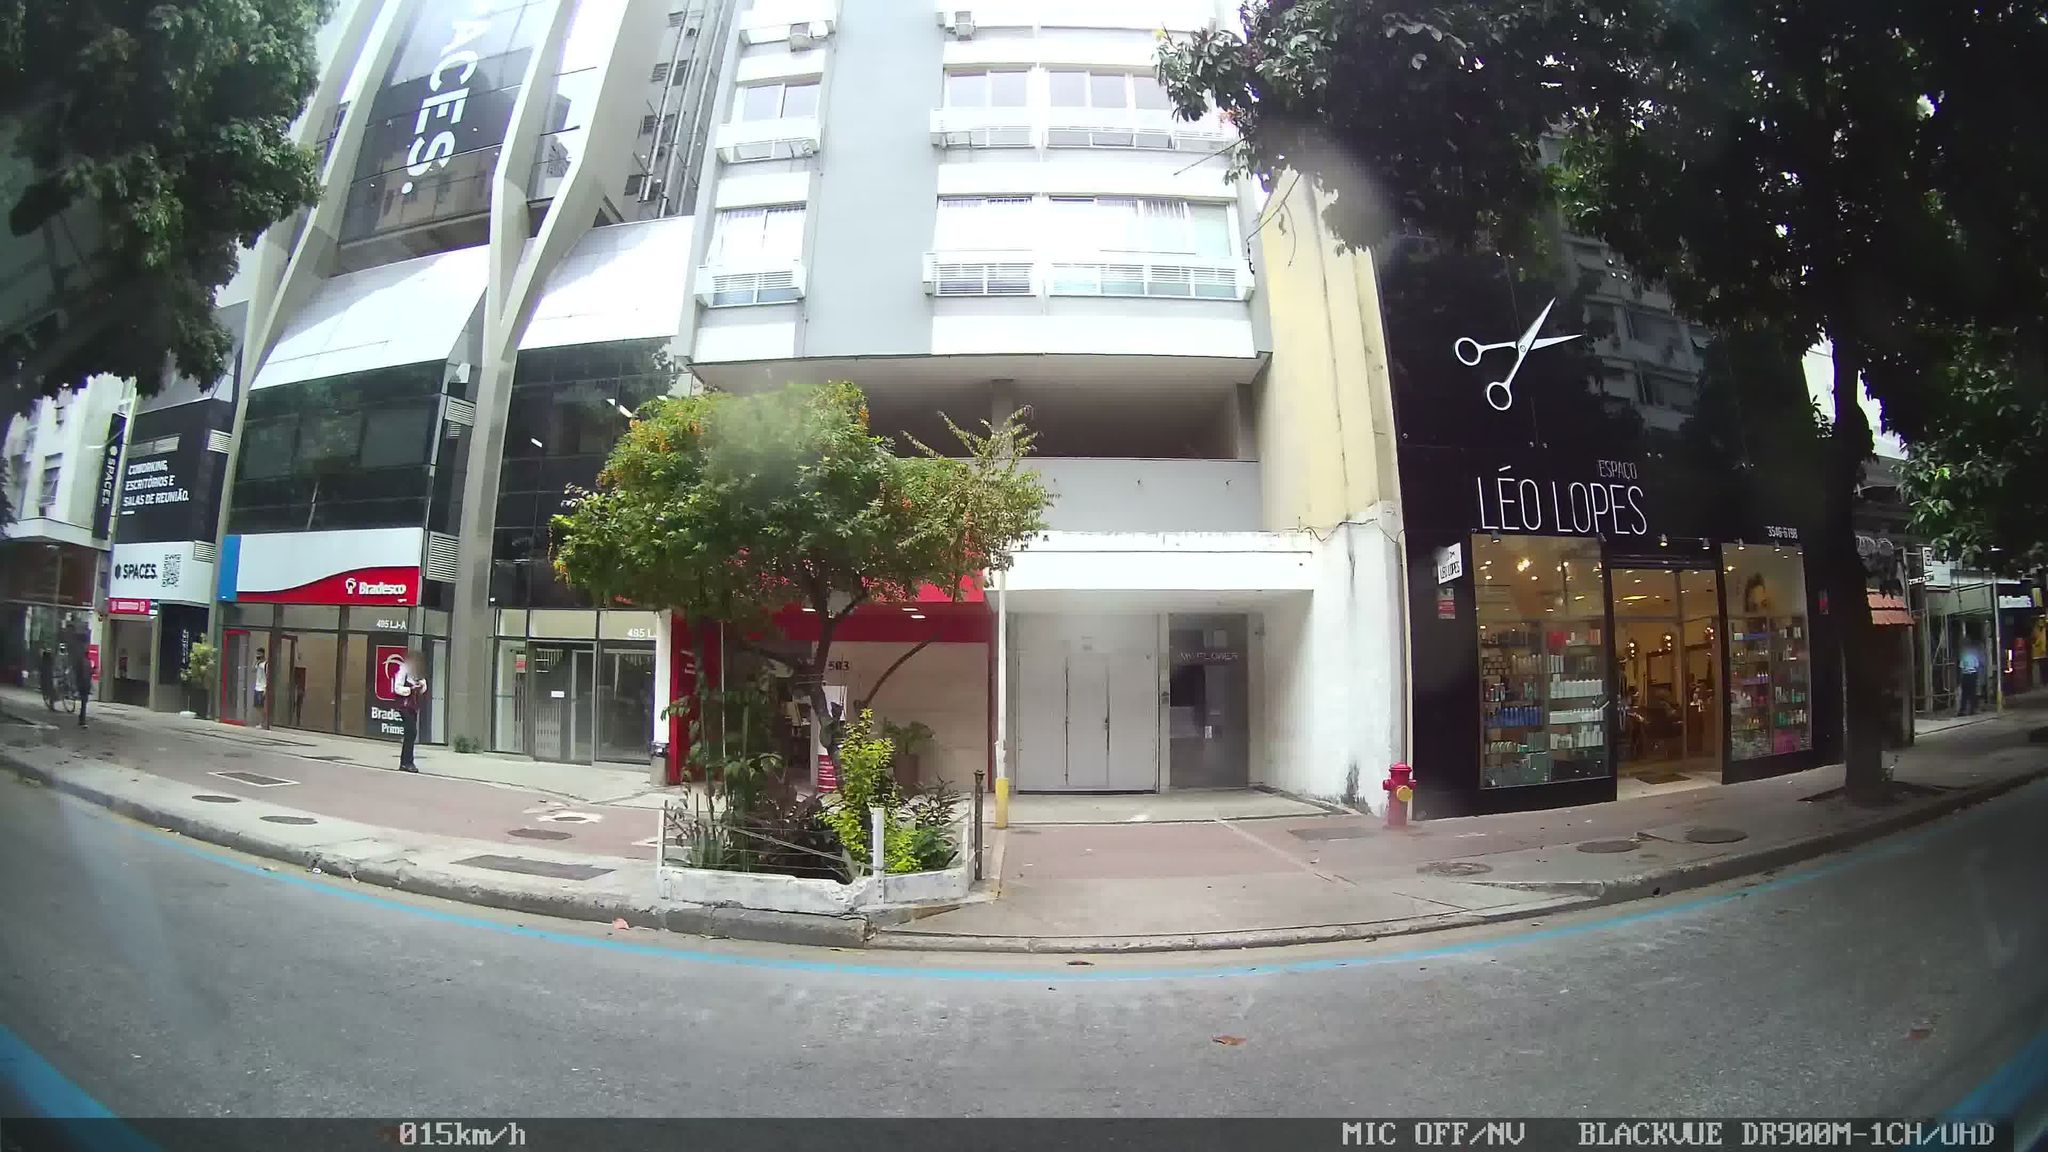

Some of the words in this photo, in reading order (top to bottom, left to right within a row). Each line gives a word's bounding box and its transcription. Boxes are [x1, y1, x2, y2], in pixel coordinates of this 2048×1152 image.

[1599, 460, 1637, 480] ESPAÇO
[1477, 465, 1541, 530] LÉO
[1552, 481, 1647, 535] LOPES
[358, 581, 407, 595] Bradesco
[381, 722, 405, 735] Prime
